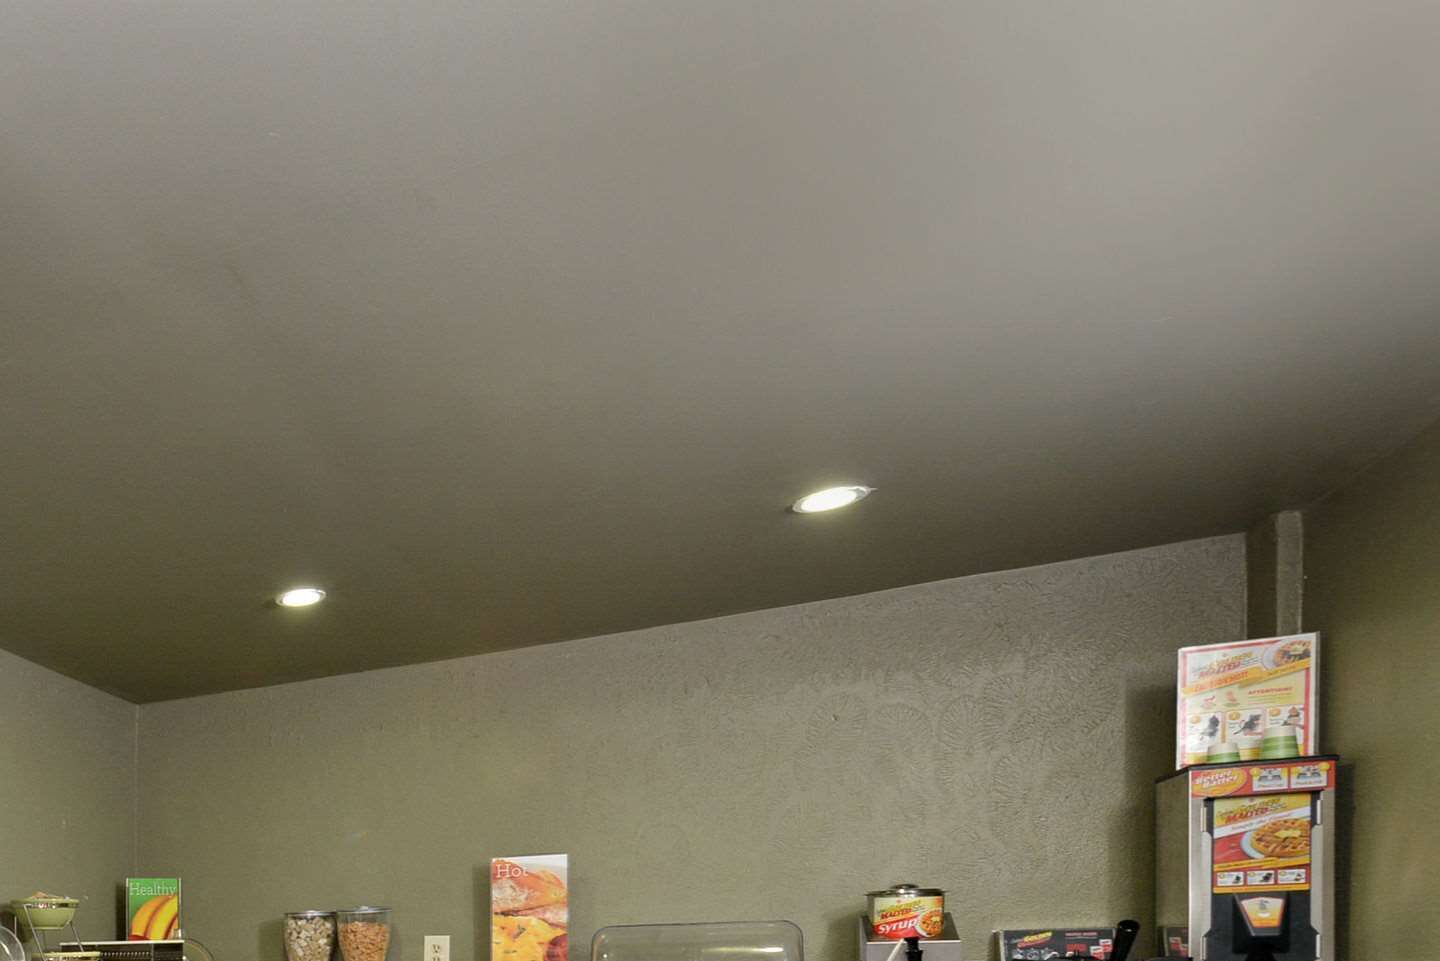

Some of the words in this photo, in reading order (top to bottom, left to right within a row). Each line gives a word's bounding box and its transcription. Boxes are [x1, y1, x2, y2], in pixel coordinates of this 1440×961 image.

[495, 863, 529, 879] Hot
[129, 880, 177, 898] Healthy
[877, 917, 918, 935] Syrup
